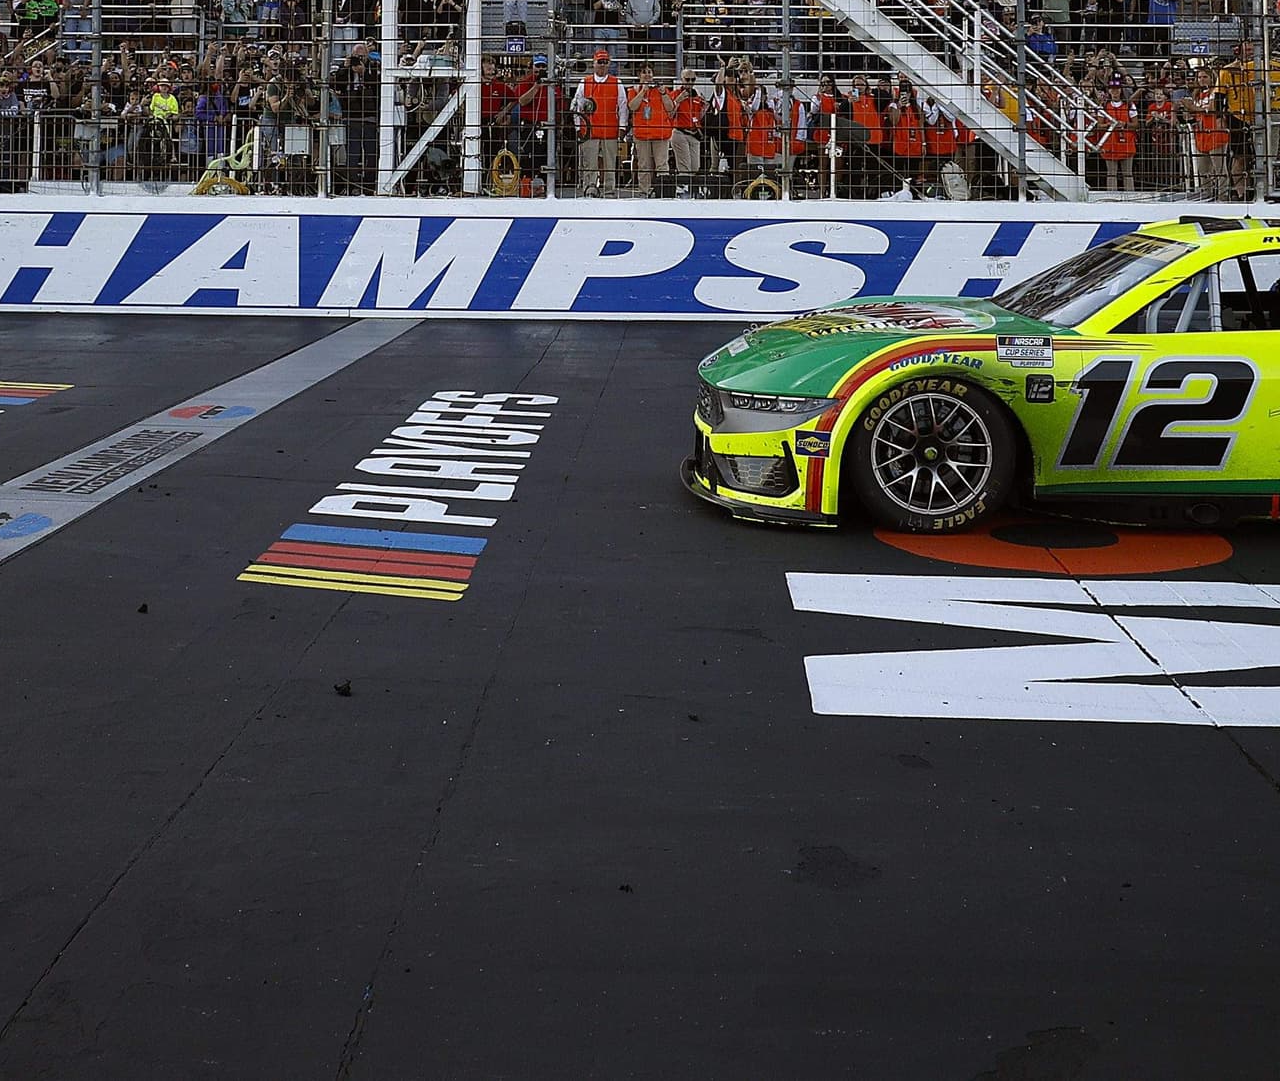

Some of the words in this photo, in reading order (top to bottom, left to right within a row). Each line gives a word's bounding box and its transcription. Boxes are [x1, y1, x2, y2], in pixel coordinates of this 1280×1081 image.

[509, 44, 522, 52] 46
[1193, 45, 1206, 53] 47
[1005, 348, 1020, 356] CUP
[1020, 349, 1045, 357] SERIES
[1014, 338, 1045, 346] NASCAR
[889, 350, 983, 371] GOODYEAR
[864, 379, 969, 431] GOODYEAR
[1054, 355, 1258, 471] 12
[309, 389, 559, 527] PLAYOFFS
[933, 500, 987, 530] EAGLE
